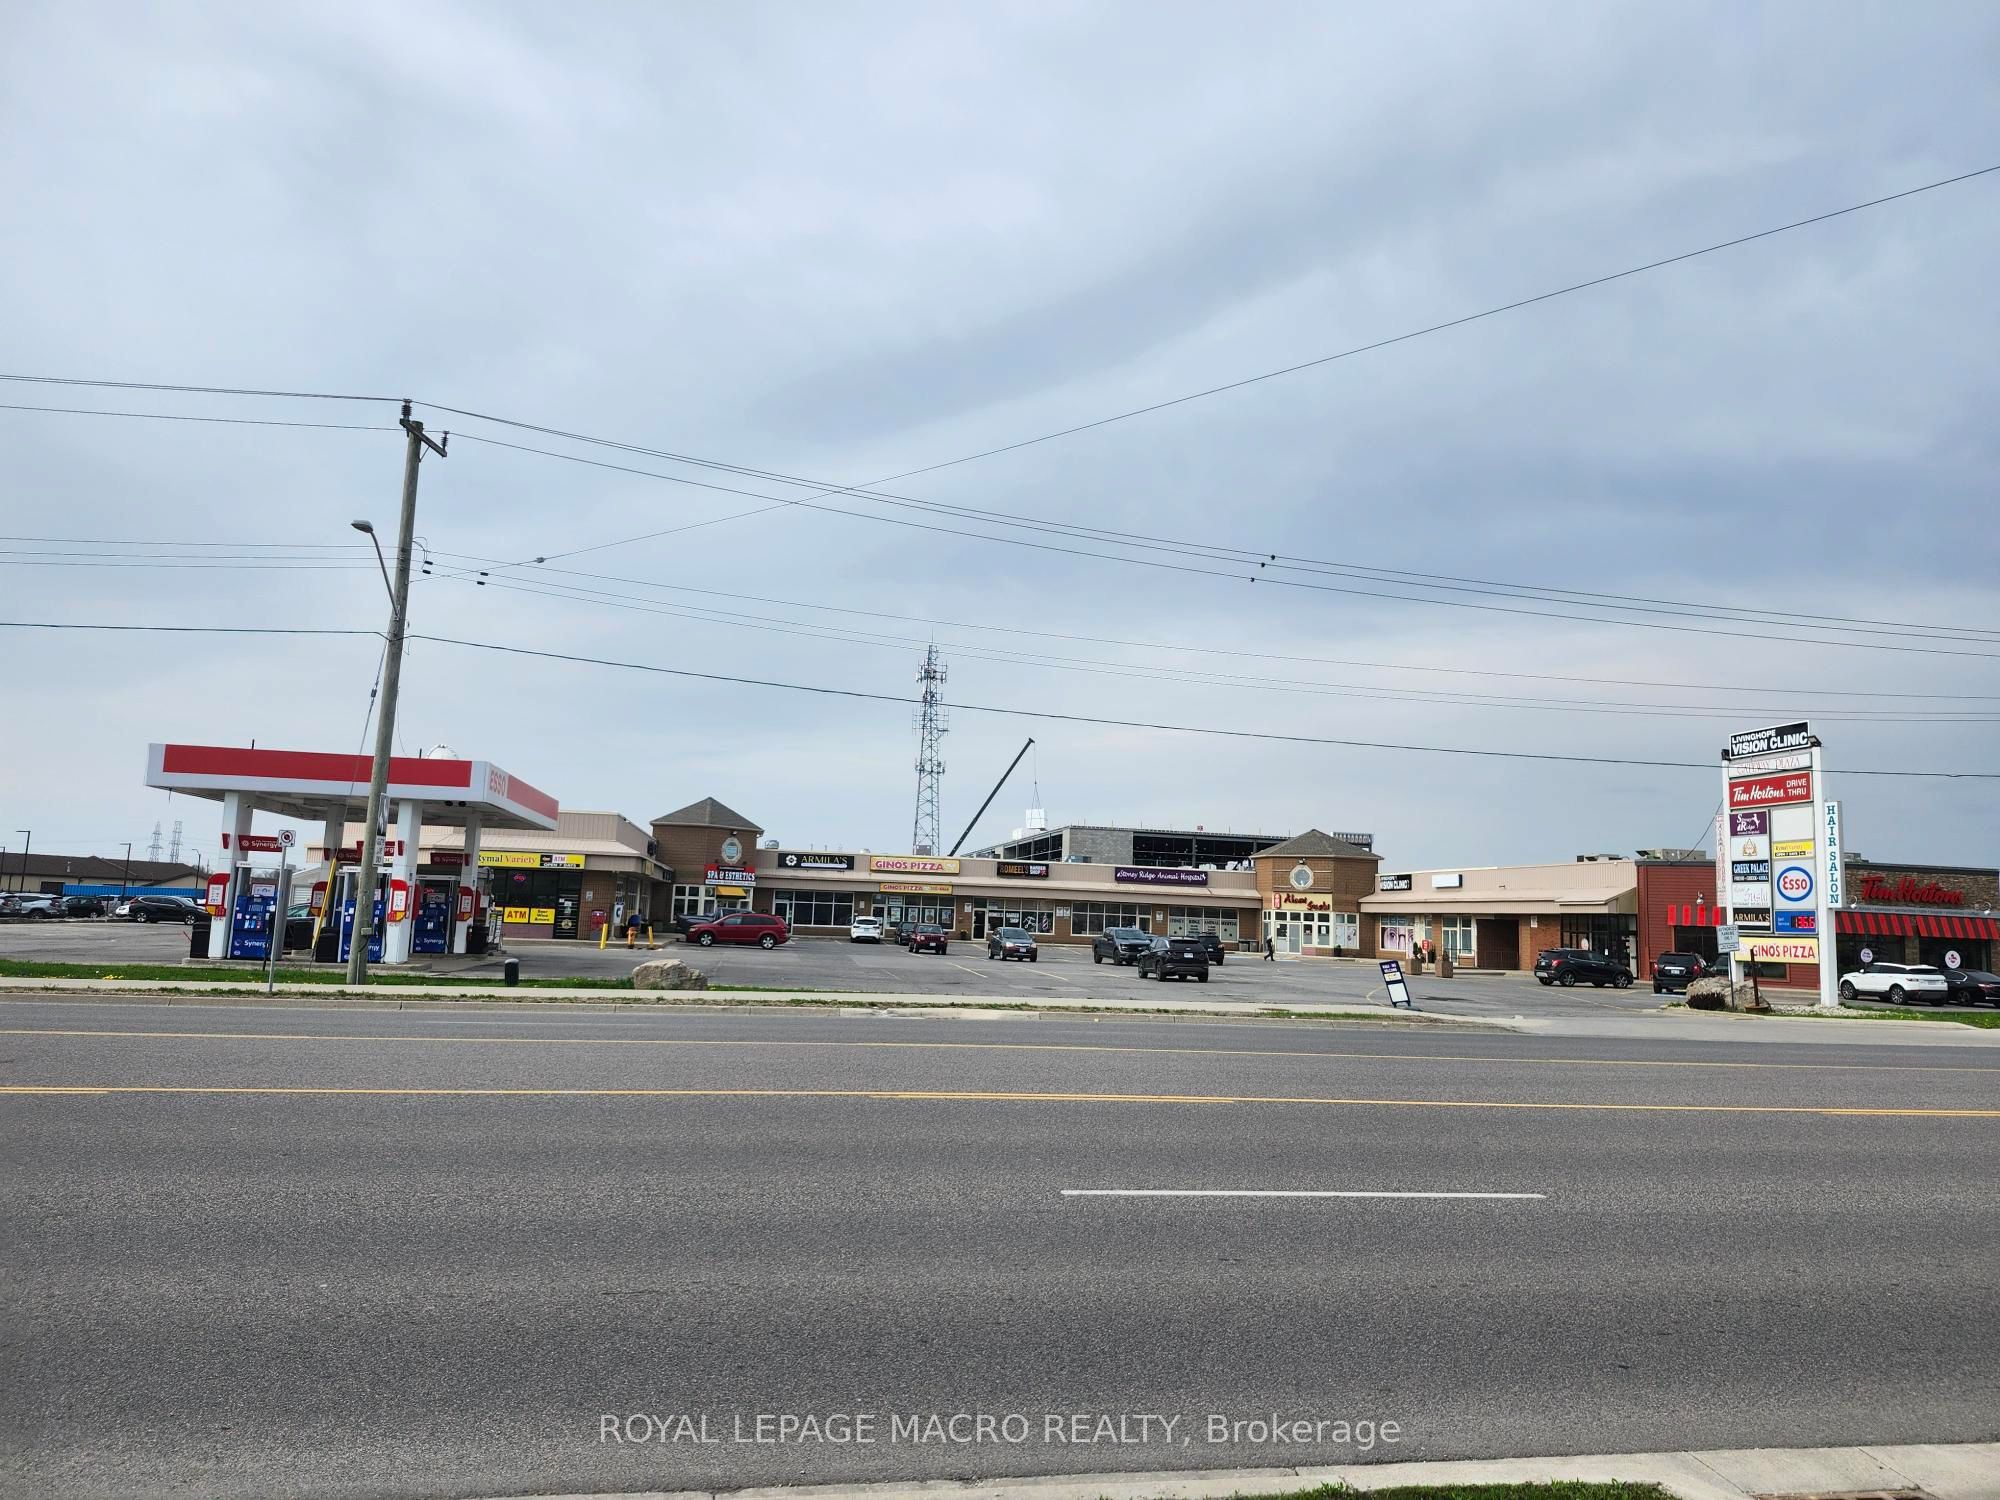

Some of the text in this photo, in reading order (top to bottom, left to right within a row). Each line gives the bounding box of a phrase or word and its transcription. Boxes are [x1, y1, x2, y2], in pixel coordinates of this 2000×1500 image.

[1731, 729, 1776, 744] LIVINGHOPE
[1732, 731, 1809, 756] VISION CLINIC
[1786, 778, 1807, 788] DRIVE
[1733, 786, 1750, 803] Tim
[1788, 787, 1808, 797] THRU
[251, 840, 279, 849] Synergy
[505, 855, 536, 865] Variety
[801, 855, 848, 865] ARMILA'S
[1827, 805, 1840, 904] HAIR SALON
[910, 861, 944, 871] PIZZA
[1733, 862, 1768, 874] GREEK PALACE
[707, 870, 719, 880] SPA
[725, 871, 756, 882] ESTHETICS
[1138, 870, 1156, 881] Ridge
[1157, 871, 1180, 881] Animal
[1859, 874, 1894, 901] Tim
[506, 910, 527, 920] ATM
[1734, 913, 1771, 923] ARMILA'S
[1782, 945, 1816, 960] PIZZA
